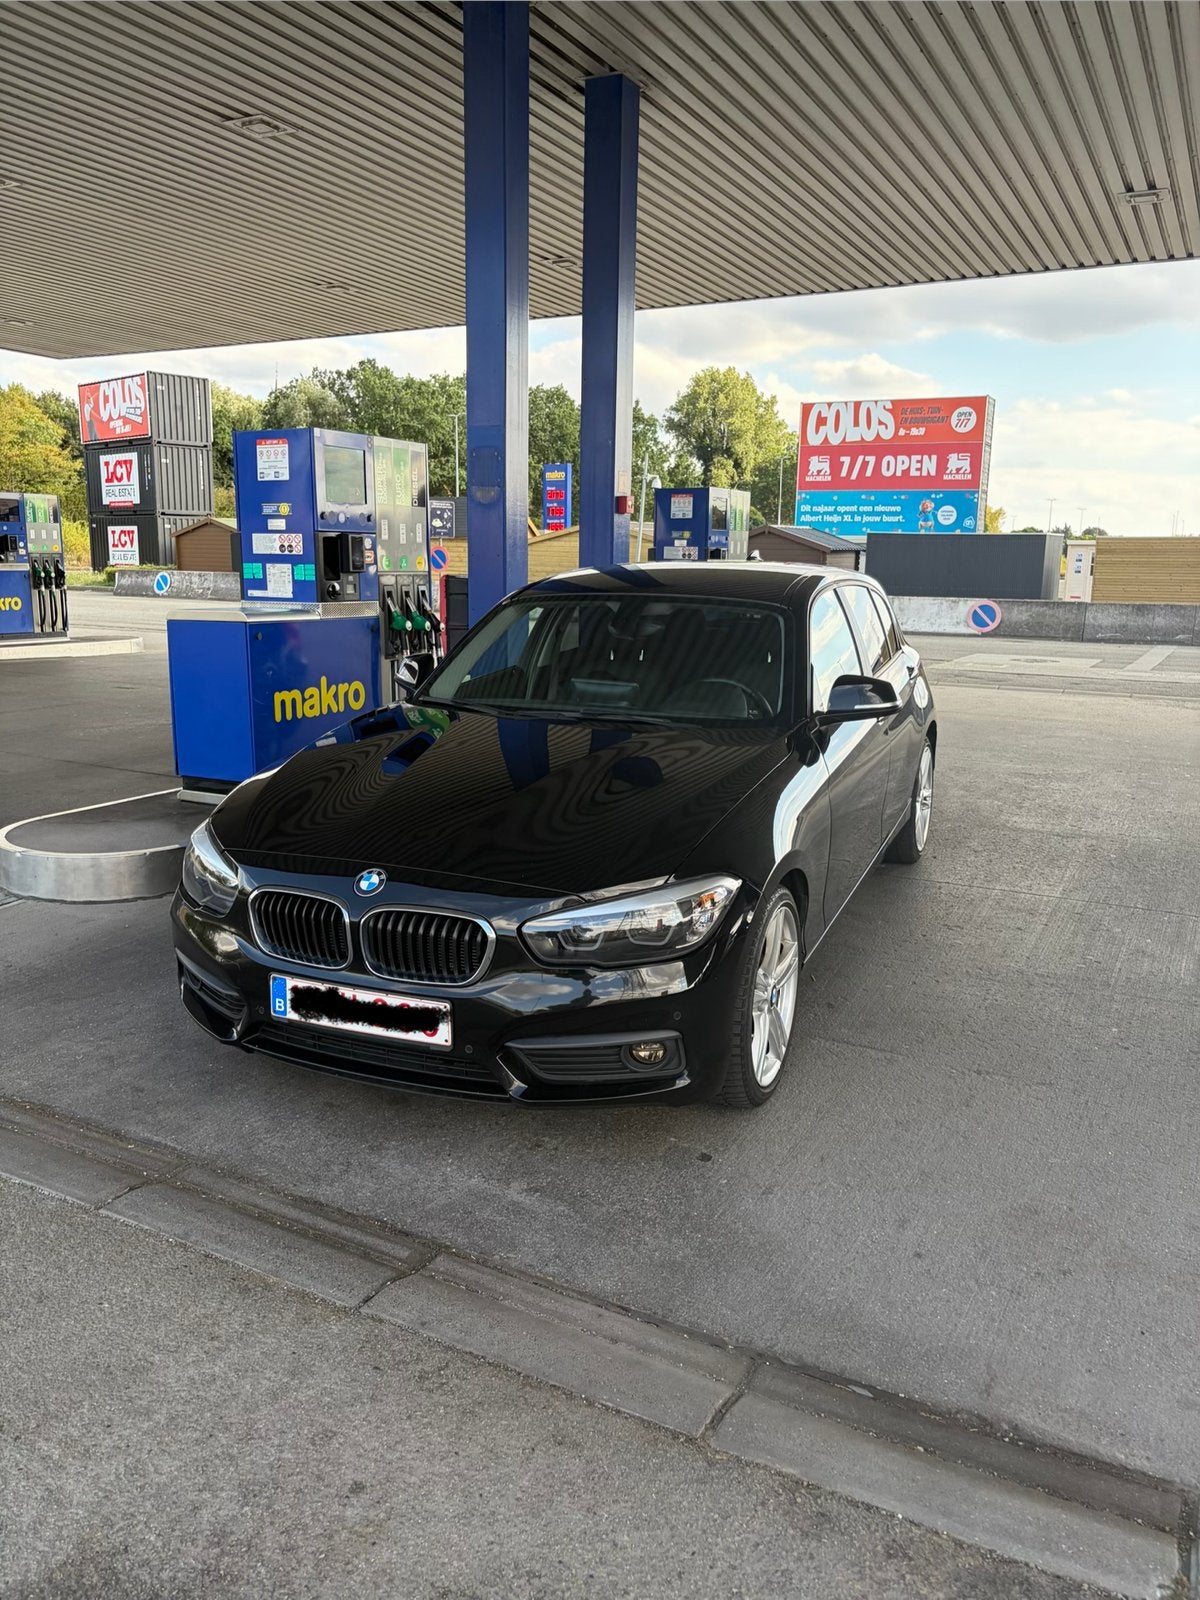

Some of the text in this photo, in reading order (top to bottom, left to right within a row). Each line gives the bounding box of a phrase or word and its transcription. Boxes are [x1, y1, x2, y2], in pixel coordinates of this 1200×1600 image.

[99, 377, 145, 422] COLOS
[806, 400, 895, 446] COLOS
[955, 418, 971, 429] 7/7
[957, 410, 973, 418] OPEN
[103, 459, 133, 483] LCV
[840, 454, 938, 480] 7/7 OPEN
[943, 473, 972, 481] MACHELEN
[411, 468, 419, 506] DIESEL
[800, 504, 812, 512] Dit
[812, 504, 836, 514] najaar
[836, 505, 858, 514] opent
[874, 504, 902, 513] nieuwe
[800, 514, 823, 522] Albert
[823, 514, 842, 523] Heijn
[854, 514, 862, 522] in
[862, 514, 881, 523] jouw
[882, 514, 906, 523] buurt.
[111, 529, 135, 549] LCV
[274, 676, 366, 723] makro
[275, 998, 285, 1012] B
